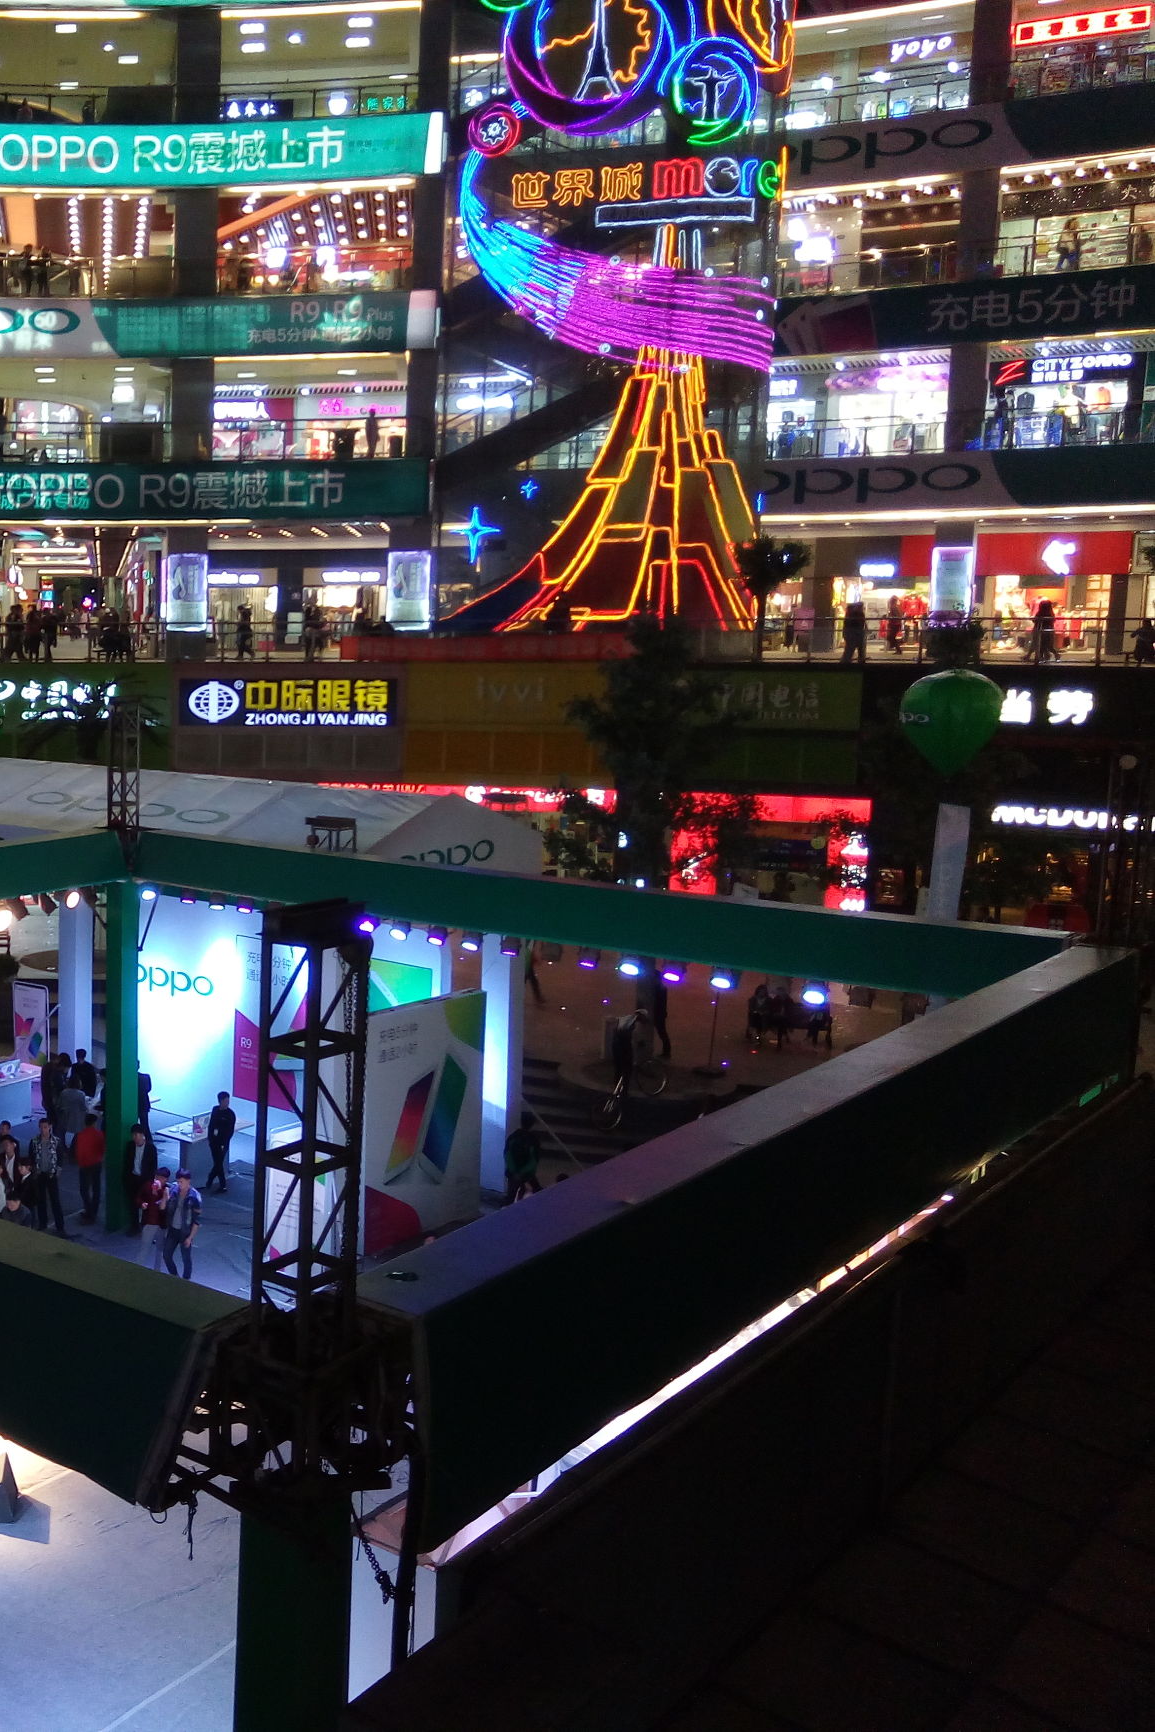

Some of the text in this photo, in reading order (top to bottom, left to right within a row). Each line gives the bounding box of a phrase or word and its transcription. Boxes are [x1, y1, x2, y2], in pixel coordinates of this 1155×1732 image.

[891, 33, 953, 62] yoyo
[290, 300, 320, 323] R9
[927, 279, 1136, 333] 充电5分钟
[245, 679, 389, 712] 中际眼镜
[244, 713, 301, 726] ZHONG
[350, 713, 388, 726] JING
